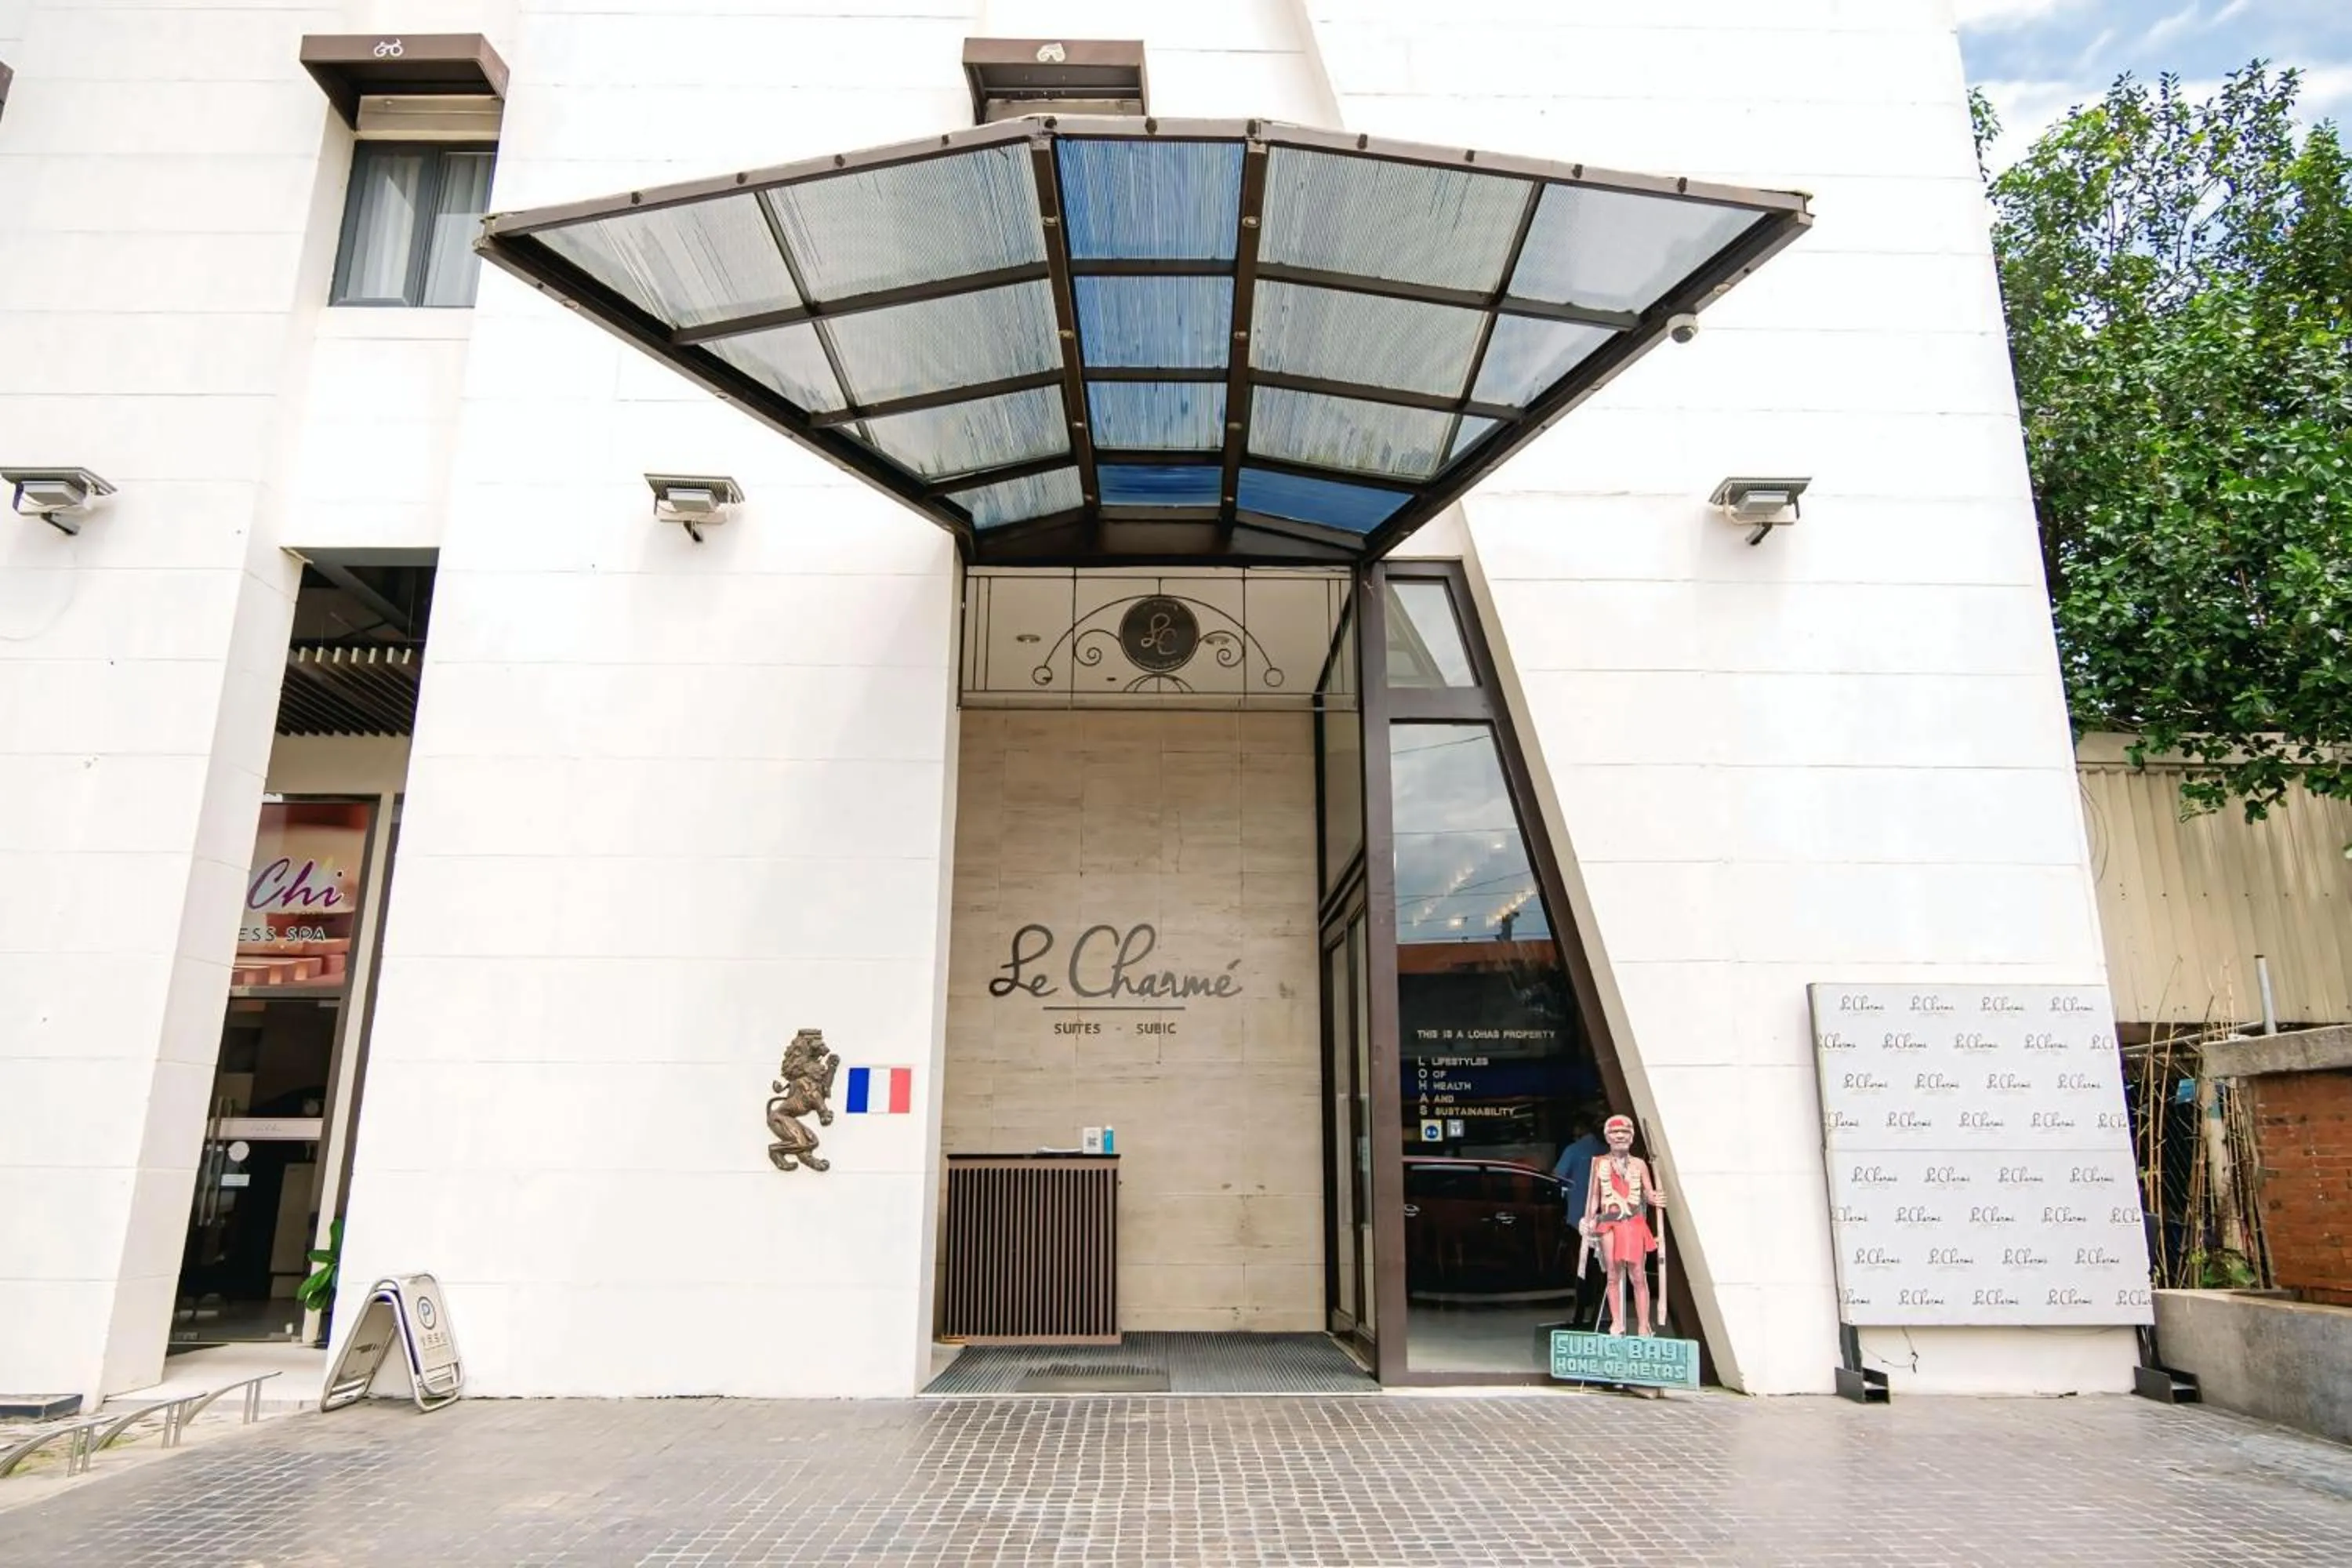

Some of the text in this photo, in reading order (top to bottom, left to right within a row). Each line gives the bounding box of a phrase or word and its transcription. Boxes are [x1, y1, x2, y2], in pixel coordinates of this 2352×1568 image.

[246, 858, 343, 909] Chi
[286, 927, 325, 942] SPA
[989, 923, 1243, 998] Le Charmé
[1054, 1023, 1101, 1034] SUITES
[1137, 1023, 1177, 1034] SUBIC
[1417, 1029, 1555, 1039] THIS IS A LOHAS PROPERTY
[1417, 1056, 1425, 1065] L
[1418, 1069, 1428, 1079] O
[1418, 1081, 1472, 1091] H HEALTH
[1419, 1093, 1454, 1103] A AND
[1419, 1105, 1515, 1116] S SUSTAINABILITY
[1555, 1334, 1677, 1361] SUBIC BAY
